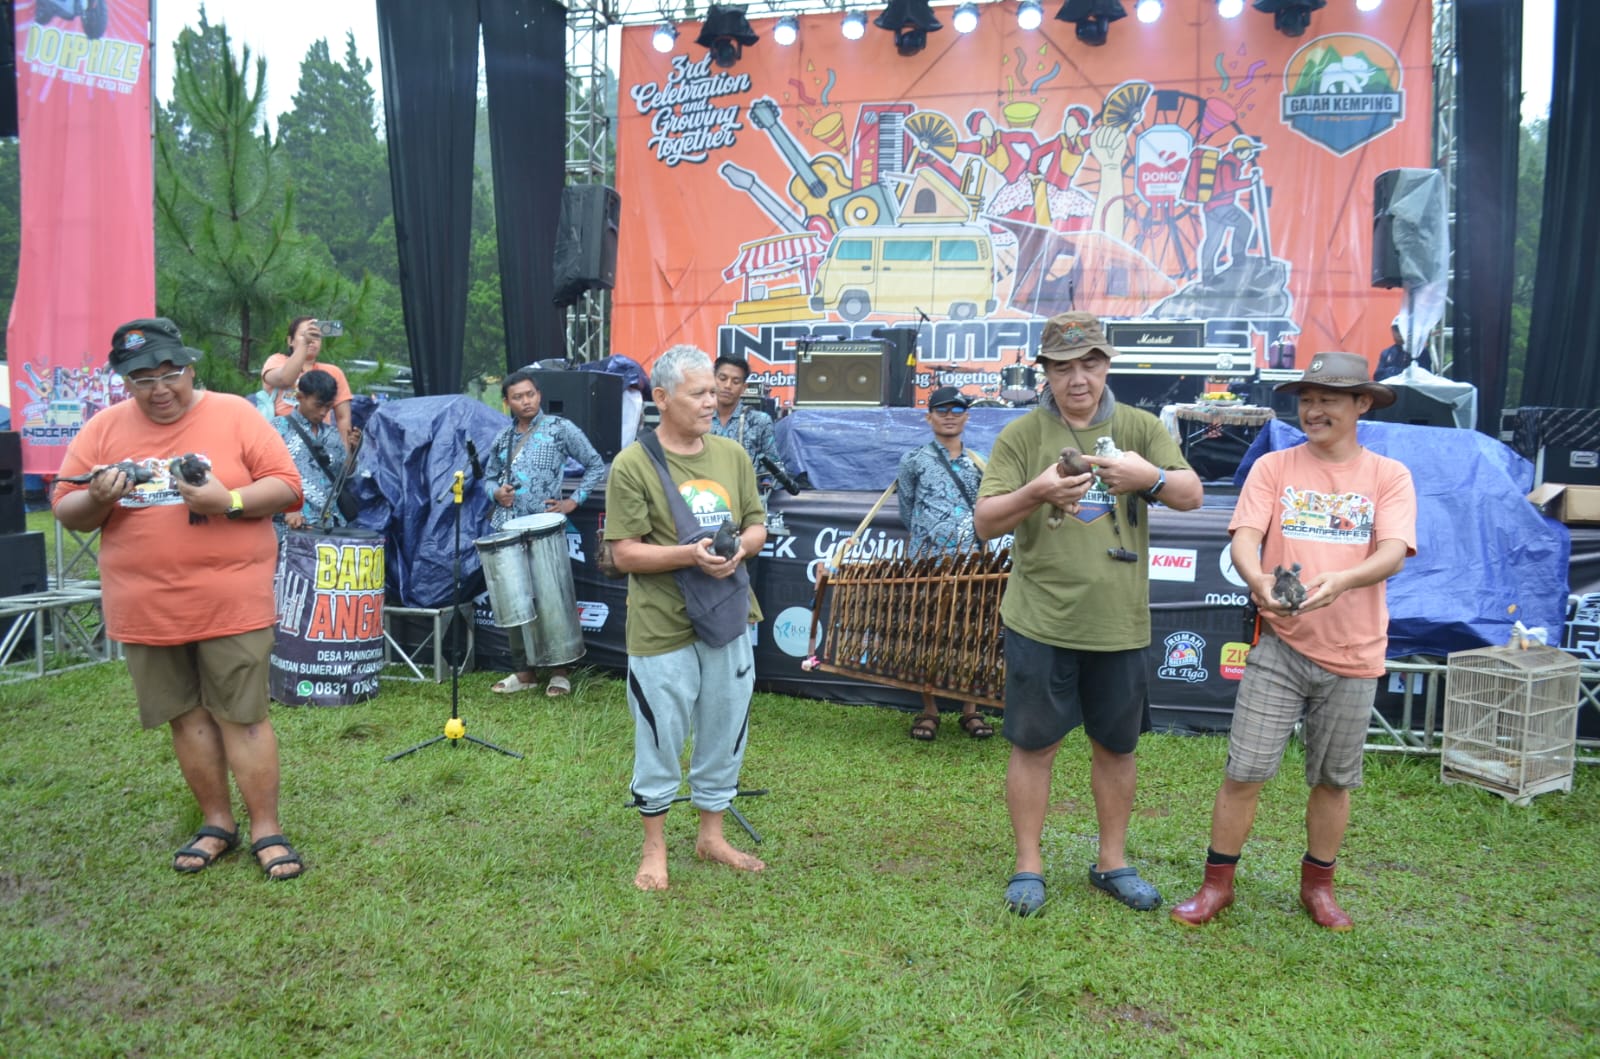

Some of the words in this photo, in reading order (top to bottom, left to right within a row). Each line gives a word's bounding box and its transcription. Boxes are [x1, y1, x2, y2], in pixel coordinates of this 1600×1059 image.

[668, 52, 712, 83] 3rd
[630, 73, 751, 114] Celebration
[681, 98, 707, 113] and
[1290, 98, 1330, 112] GAJAH
[1333, 96, 1393, 110] KEMPING
[651, 105, 743, 137] Growing
[647, 126, 736, 166] Together
[1136, 334, 1175, 344] Marshall
[1152, 555, 1193, 568] KING
[1205, 593, 1248, 606] moto
[1168, 634, 1202, 647] RUMAH
[318, 651, 341, 661] DESA
[1180, 667, 1204, 680] Tiga
[315, 682, 347, 695] 0831
